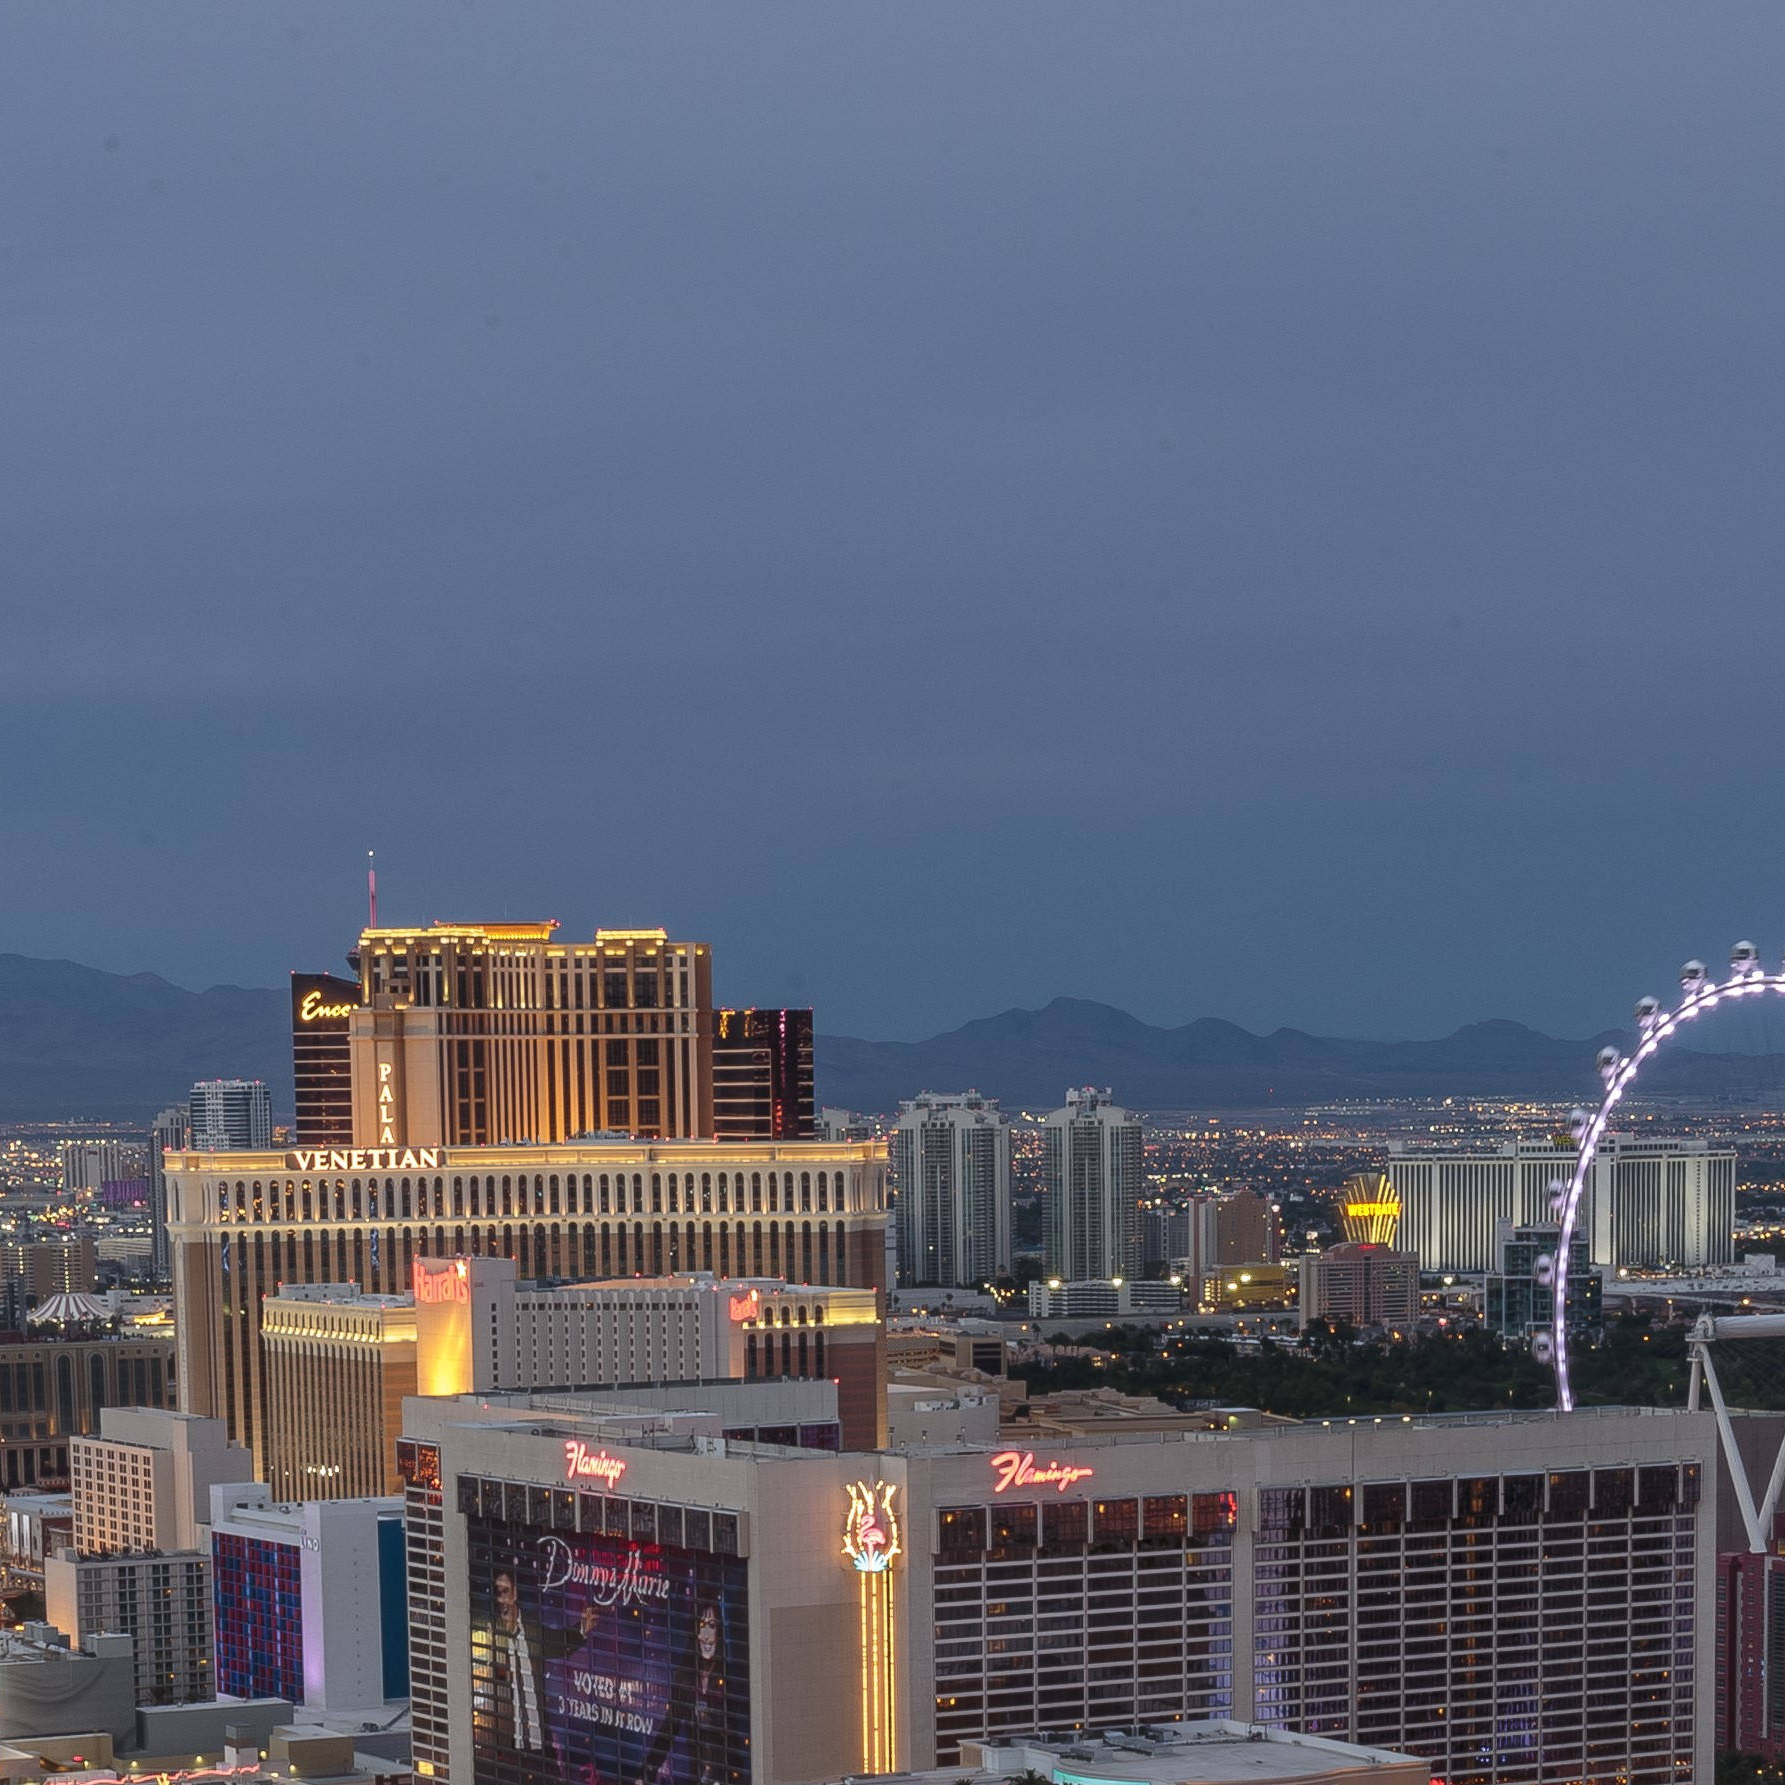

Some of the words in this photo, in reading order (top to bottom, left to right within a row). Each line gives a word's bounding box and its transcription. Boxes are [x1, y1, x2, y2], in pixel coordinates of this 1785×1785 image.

[378, 1063, 395, 1144] PALA
[293, 1148, 440, 1171] VENETIAN
[1347, 1203, 1400, 1217] WESTGATE
[565, 1440, 626, 1489] Flamingo
[990, 1451, 1093, 1492] Flamingo
[573, 1670, 614, 1699] VOTED
[559, 1696, 564, 1715] 3
[566, 1698, 598, 1722] YEARS
[600, 1705, 613, 1725] IN
[626, 1712, 654, 1735] ROW
